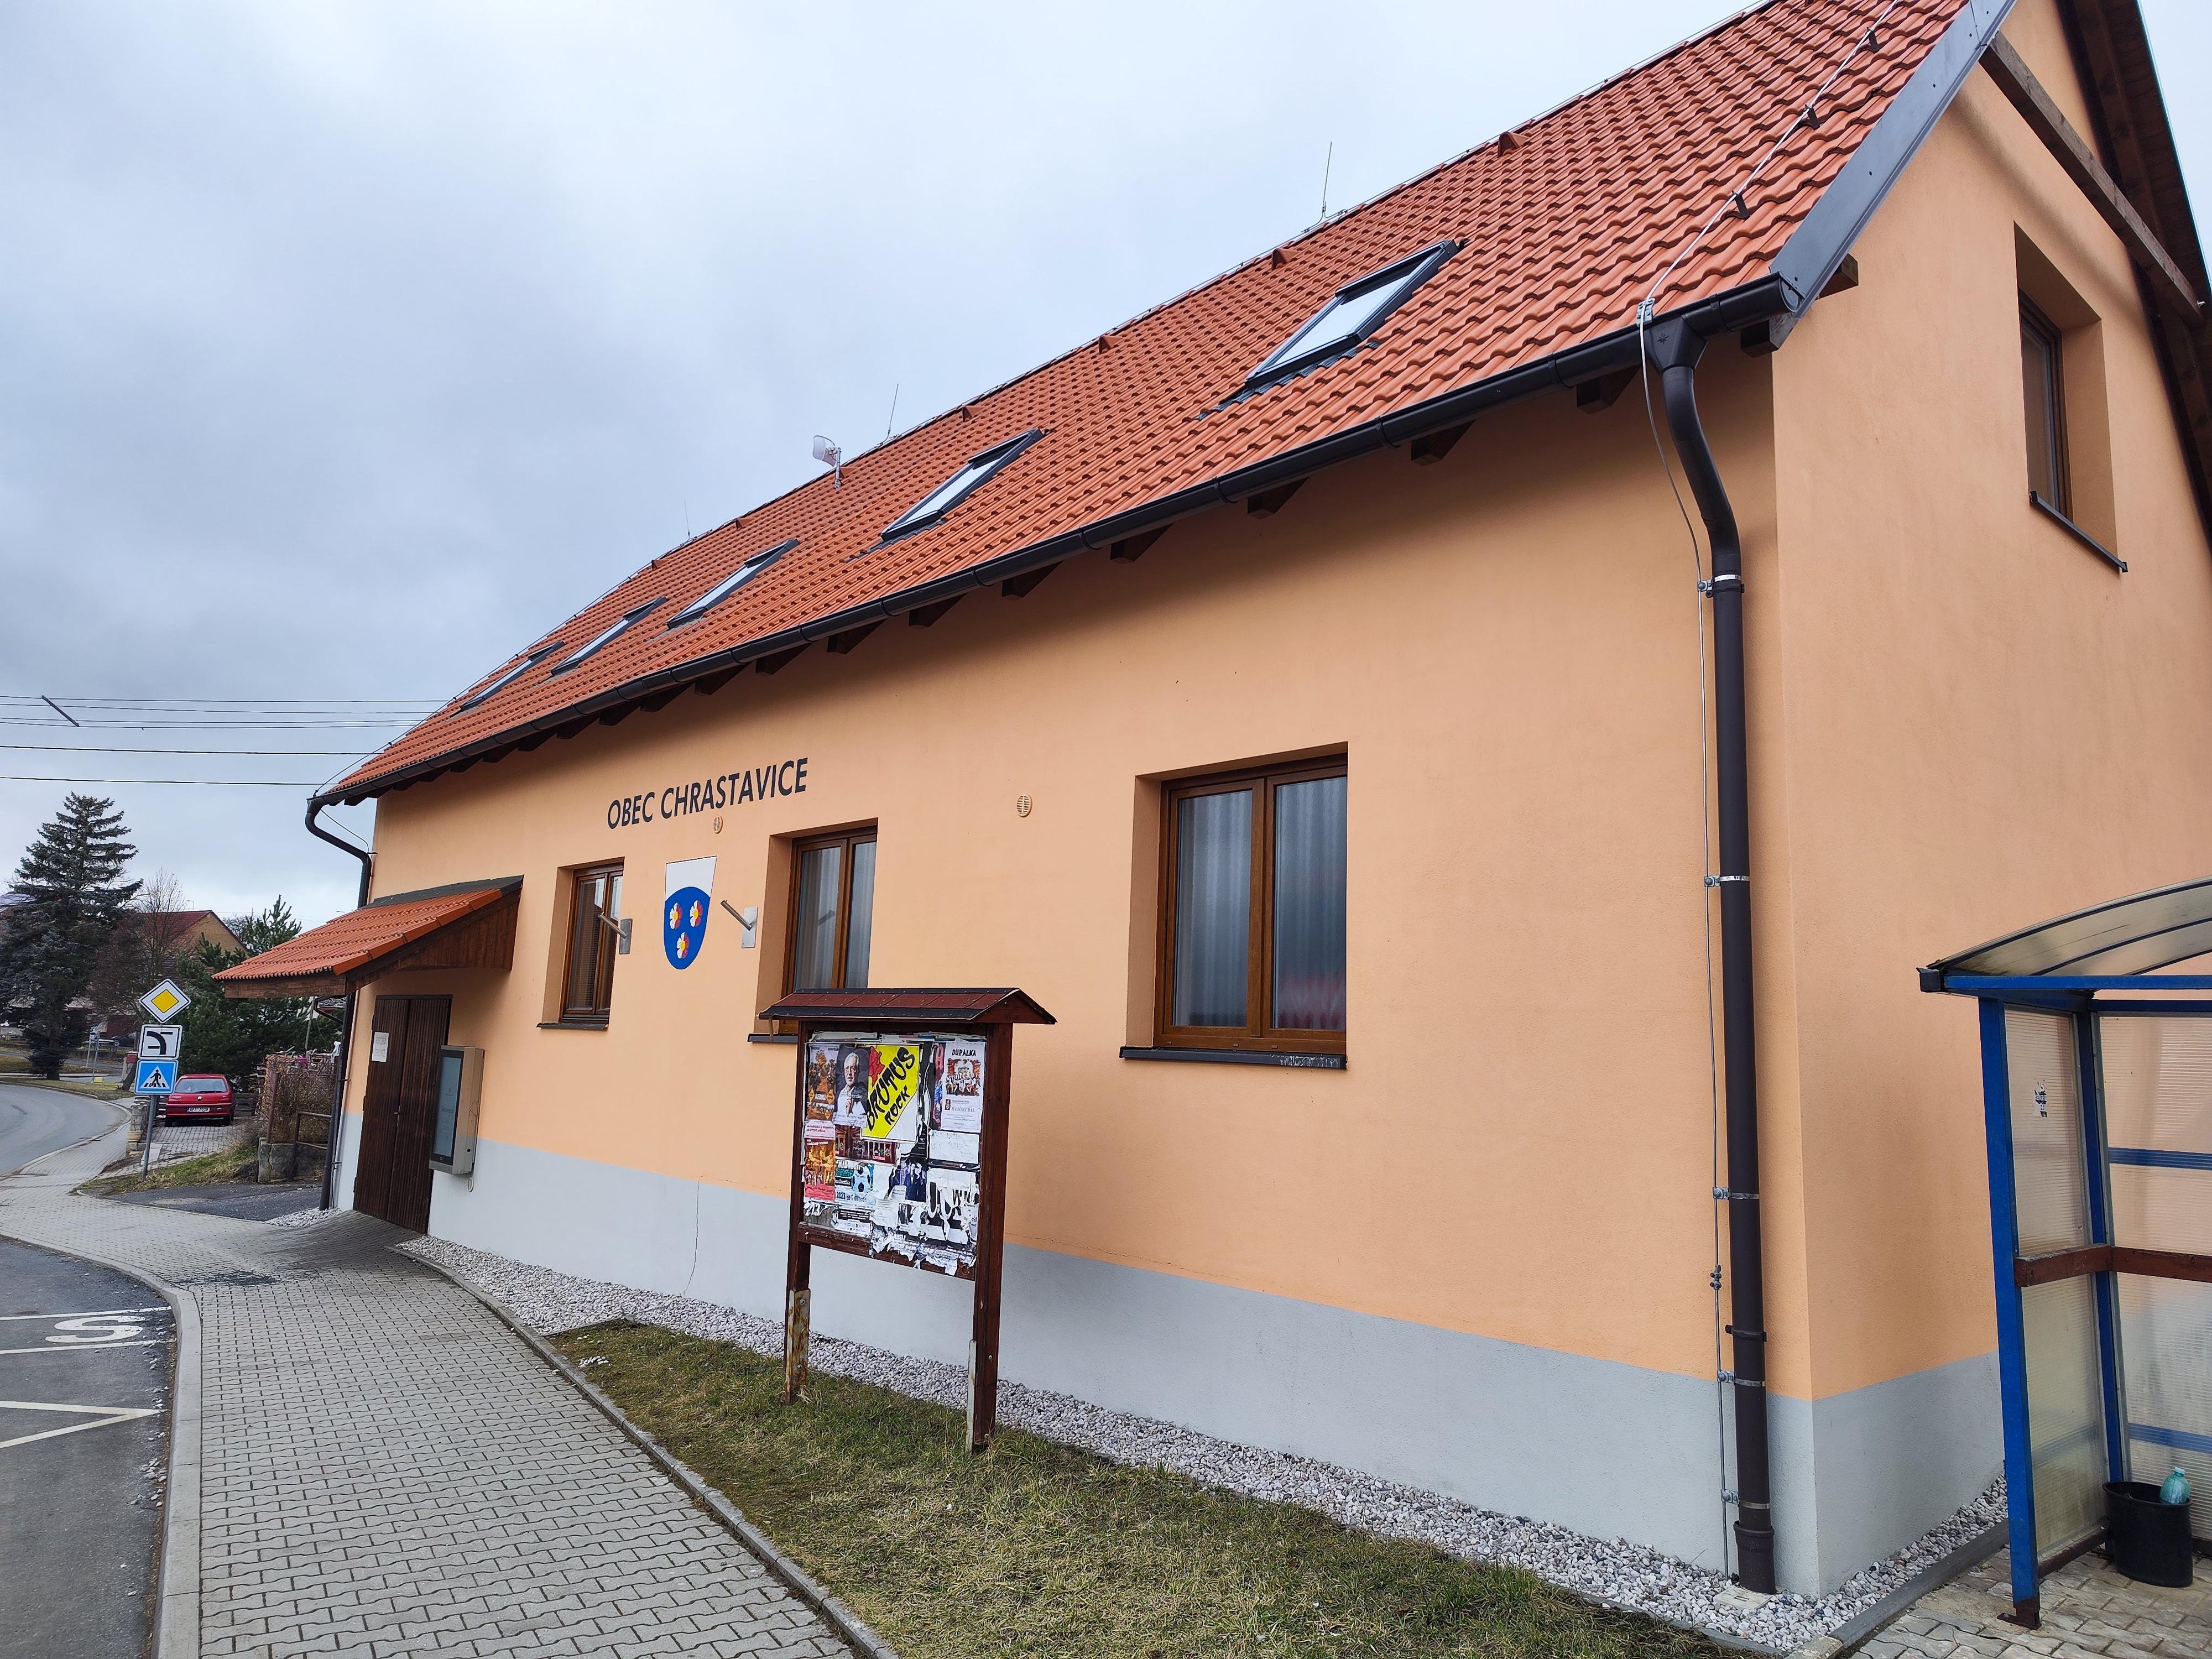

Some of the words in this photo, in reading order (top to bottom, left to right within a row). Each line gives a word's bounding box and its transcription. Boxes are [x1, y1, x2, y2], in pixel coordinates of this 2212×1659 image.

[607, 792, 655, 830] OBEC
[661, 757, 808, 819] CHRASTAVICE
[867, 1046, 916, 1132] BRUTUS
[884, 1086, 911, 1125] ROCK
